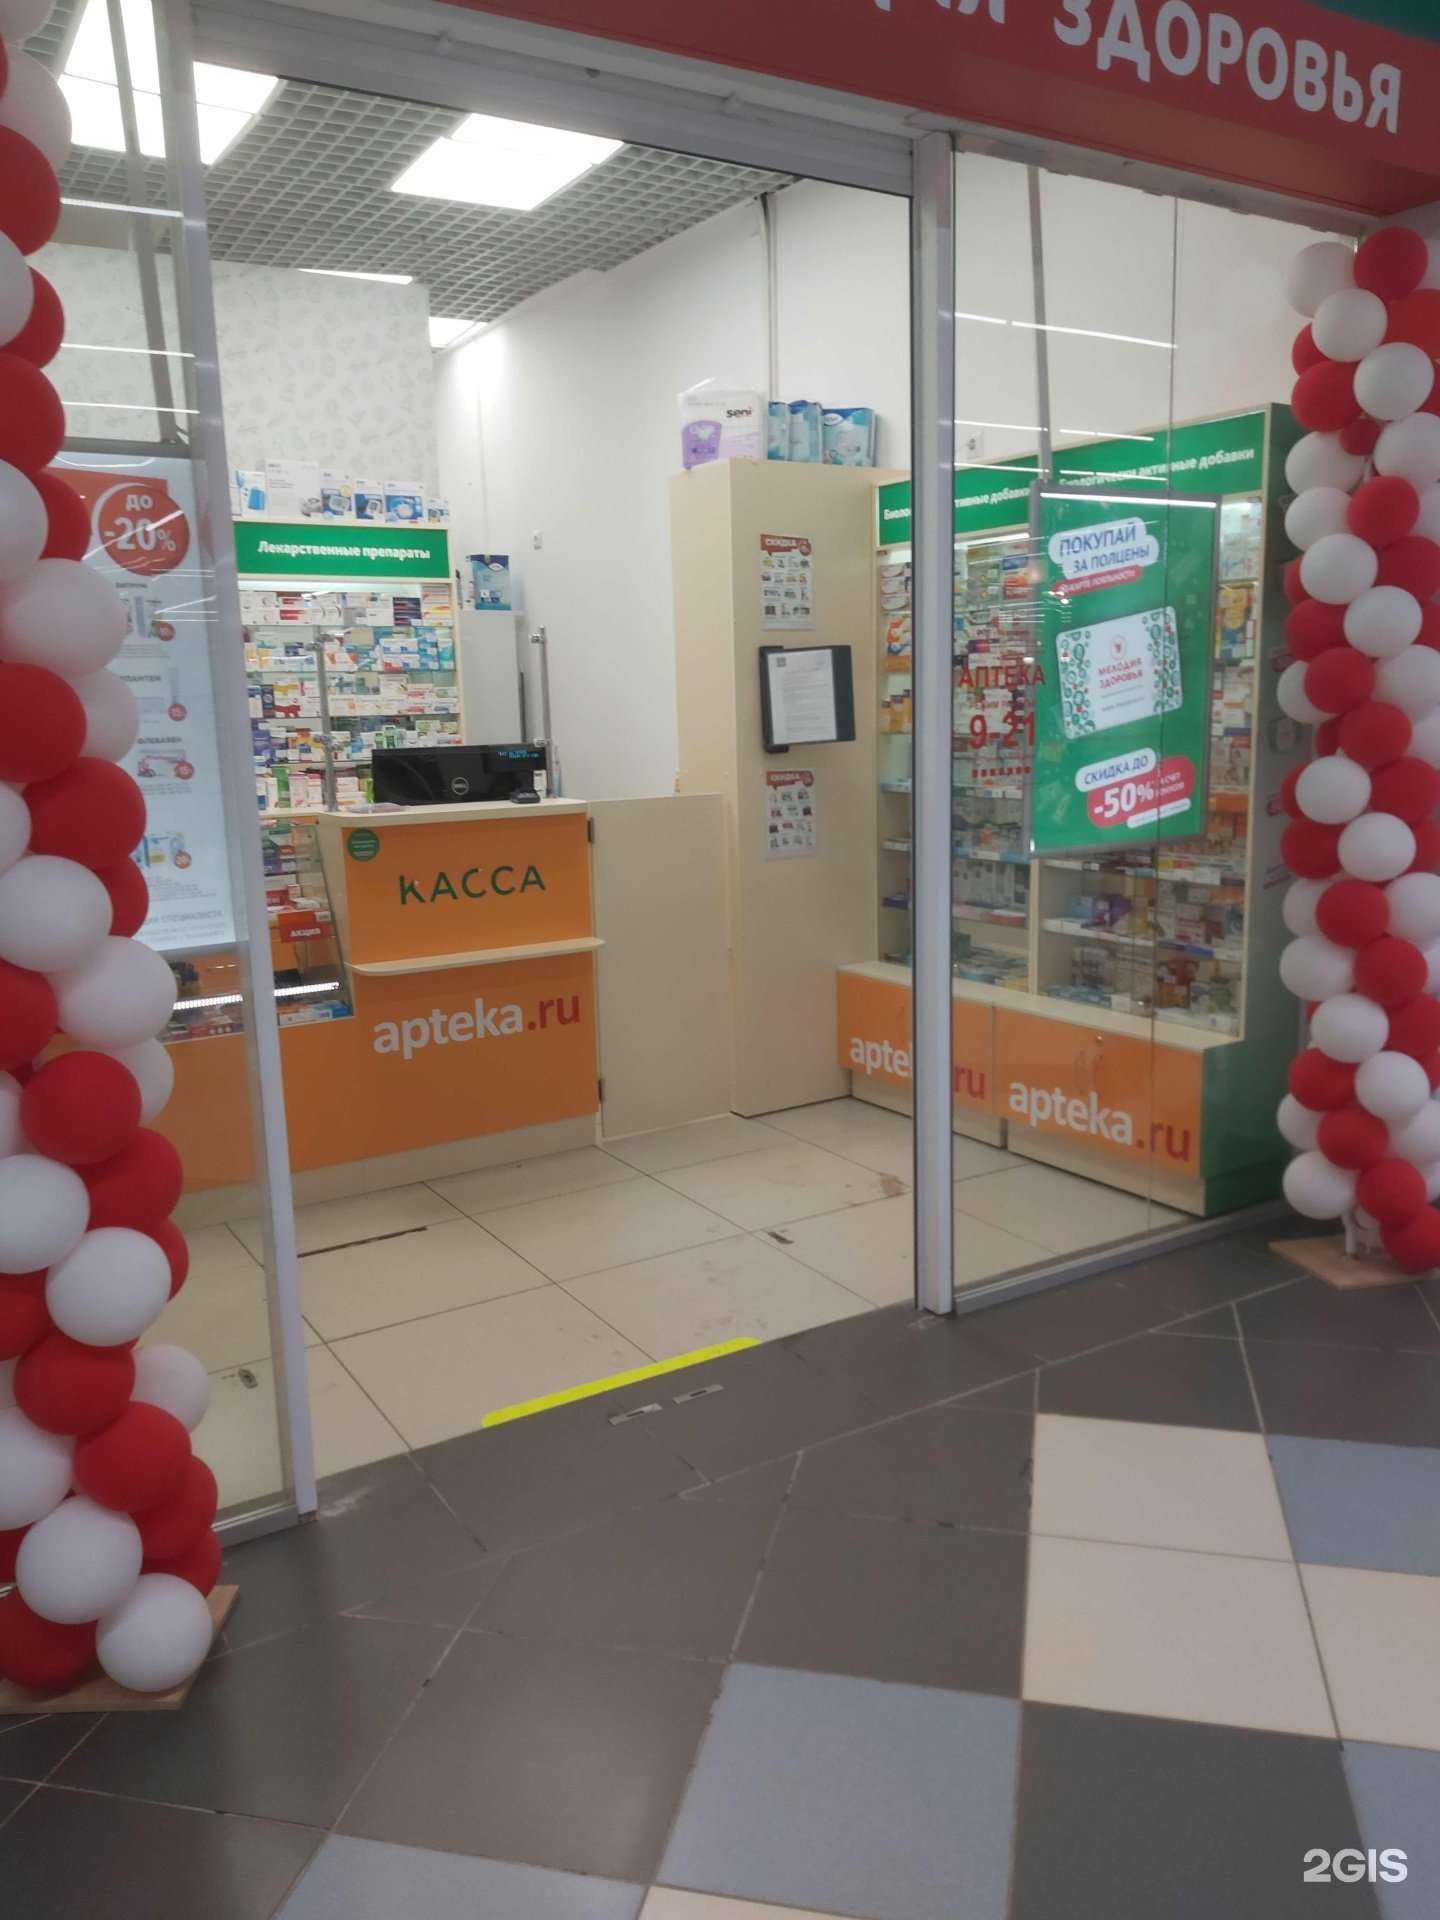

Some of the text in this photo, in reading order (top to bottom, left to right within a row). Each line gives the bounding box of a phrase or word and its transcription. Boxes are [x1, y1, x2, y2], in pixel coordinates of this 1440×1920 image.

[1053, 0, 1401, 134] ЗДОРОВЬЯ
[1198, 449, 1255, 470] добавки
[954, 494, 990, 508] тивные
[103, 517, 177, 551] -20%
[257, 540, 431, 562] Лекарственные препараты
[1059, 521, 1138, 558] ПОКУПАЙ
[1072, 544, 1150, 574] ЗА ПОЛЦЕНЫ
[959, 665, 1046, 690] АПТЕКА
[968, 712, 1036, 750] 9-21
[1083, 755, 1149, 785] СКИДКА ДО
[1093, 781, 1155, 819] -50%
[399, 864, 547, 906] КАССА
[372, 995, 581, 1061] apteka.ru
[1008, 1080, 1191, 1163] apteka.ru
